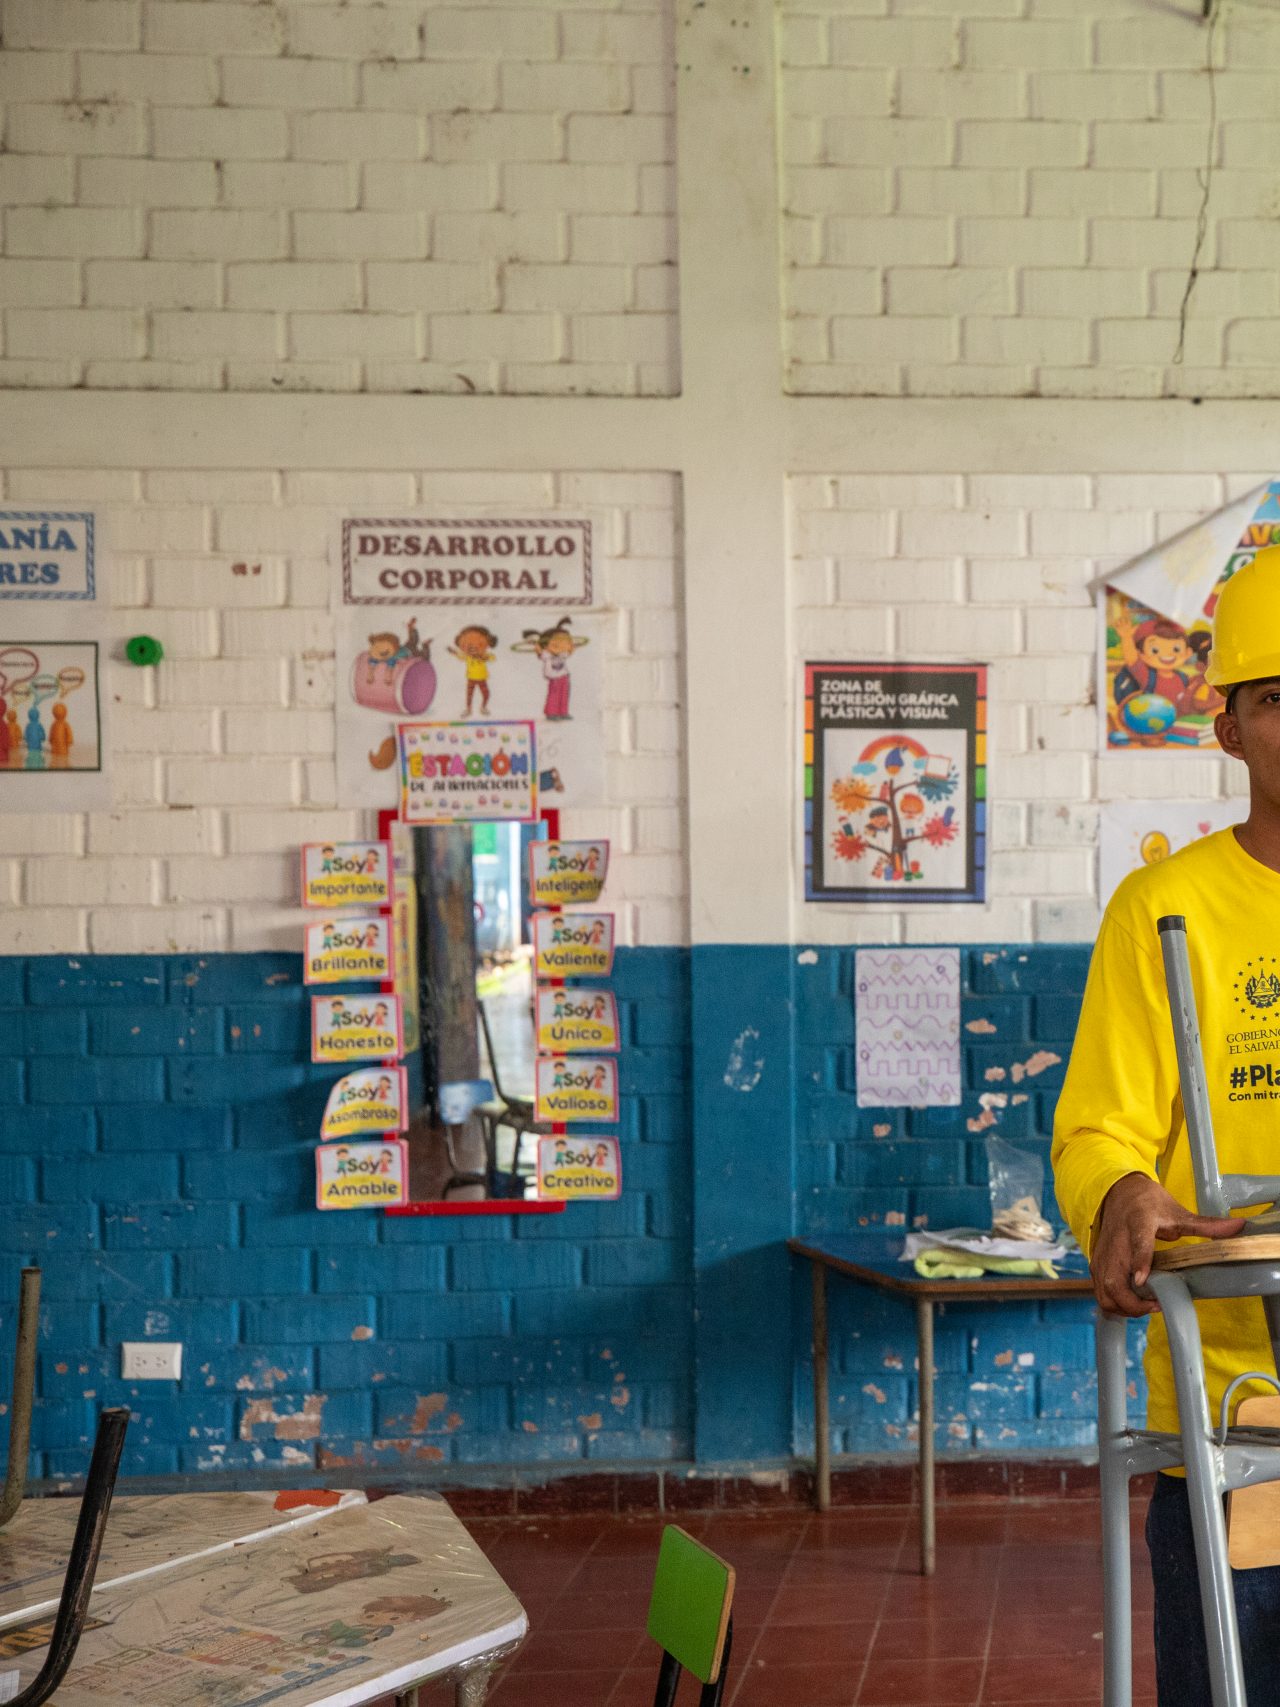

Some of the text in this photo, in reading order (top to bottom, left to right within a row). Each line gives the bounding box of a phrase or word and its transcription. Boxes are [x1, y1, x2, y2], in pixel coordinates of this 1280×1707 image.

[358, 534, 576, 556] DESARROLLO
[379, 569, 558, 590] CORPORAL
[821, 680, 882, 692] ZONA DE
[820, 690, 959, 706] EXPRESIÓN GRÁFICA
[821, 704, 949, 719] PLÁSTICA Y VISUAL
[333, 857, 366, 875] Soy
[558, 856, 589, 873] Soy
[310, 881, 385, 897] Importante
[333, 933, 366, 949] Soy
[561, 928, 592, 945] Soy
[312, 956, 385, 972] Brillante
[542, 952, 607, 967] Valiente
[341, 1011, 374, 1027] Soy
[563, 1004, 595, 1019] Soy
[551, 1024, 603, 1042] Único
[320, 1034, 395, 1050] Honesto
[1229, 1045, 1242, 1054] EL
[563, 1074, 595, 1091] Soy
[347, 1086, 378, 1102] Soy
[1229, 1093, 1251, 1101] Con
[1254, 1091, 1267, 1099] mi
[546, 1095, 608, 1111] Valioso
[328, 1106, 397, 1127] Asombroso
[347, 1159, 380, 1176] Soy
[564, 1151, 596, 1168] Soy
[327, 1181, 398, 1198] Amable
[543, 1174, 615, 1191] Creativo
